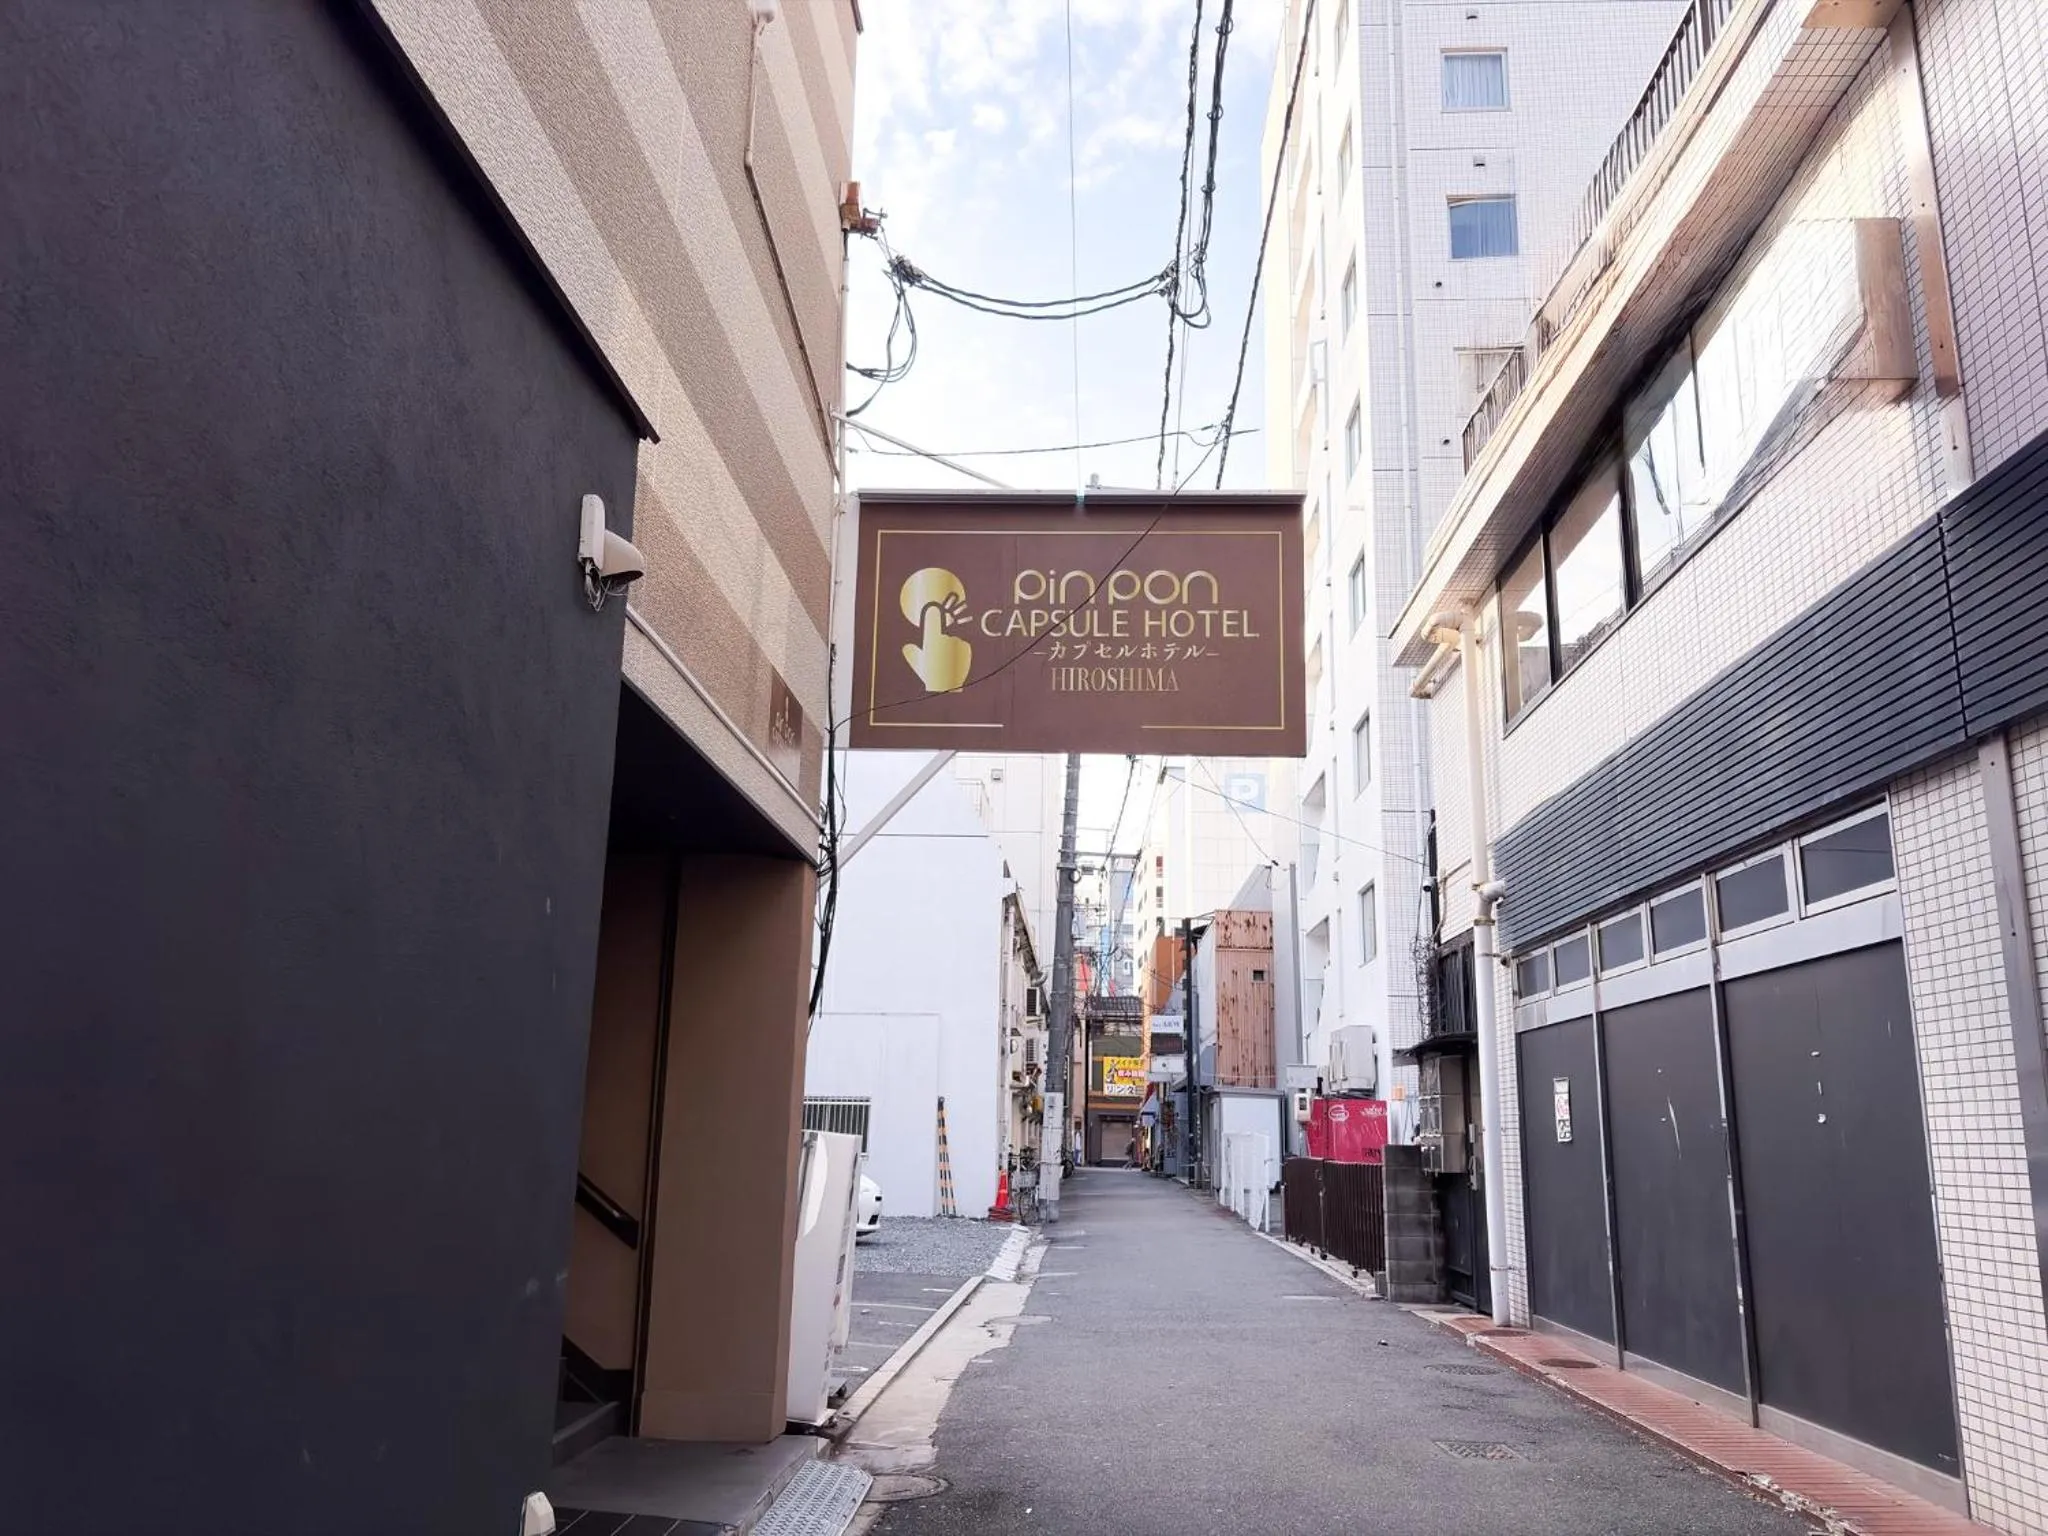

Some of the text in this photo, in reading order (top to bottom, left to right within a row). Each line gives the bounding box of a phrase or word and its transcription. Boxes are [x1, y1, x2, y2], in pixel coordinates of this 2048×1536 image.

[980, 609, 1260, 638] CAPSULE HOTEL
[1048, 641, 1206, 662] カプセルホテル
[1051, 667, 1180, 692] HIROSHIMA
[1230, 778, 1260, 808] P
